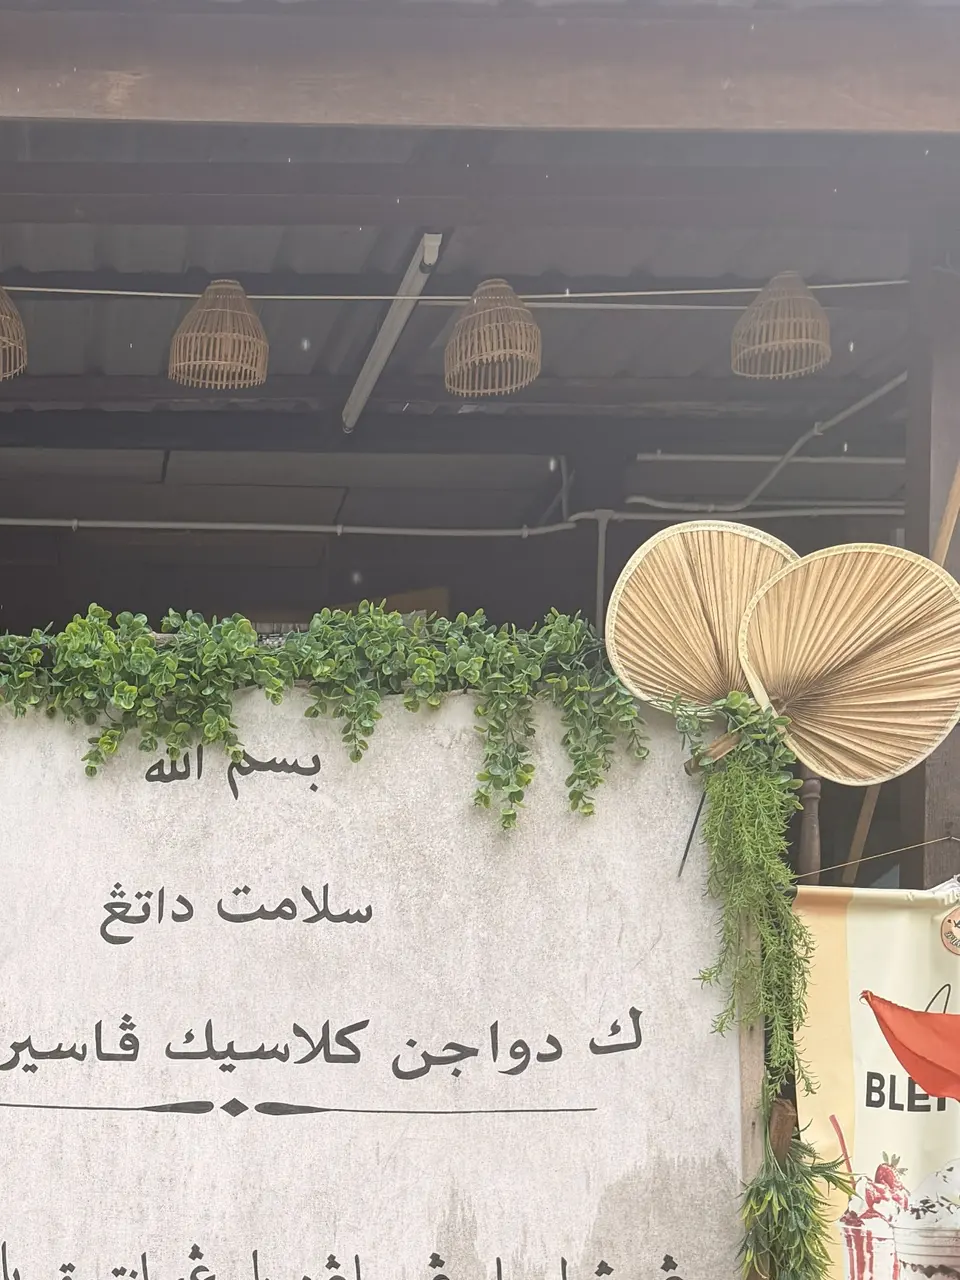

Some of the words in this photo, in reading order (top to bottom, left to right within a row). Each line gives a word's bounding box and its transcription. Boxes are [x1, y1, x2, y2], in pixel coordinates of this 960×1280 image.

[144, 743, 204, 783] الله
[227, 748, 321, 800] بسم
[216, 883, 373, 923] سلامت
[164, 1018, 370, 1074] كلاسيك
[391, 1019, 563, 1080] دواجن
[588, 1006, 643, 1056] ك
[865, 1070, 947, 1113] BLE
